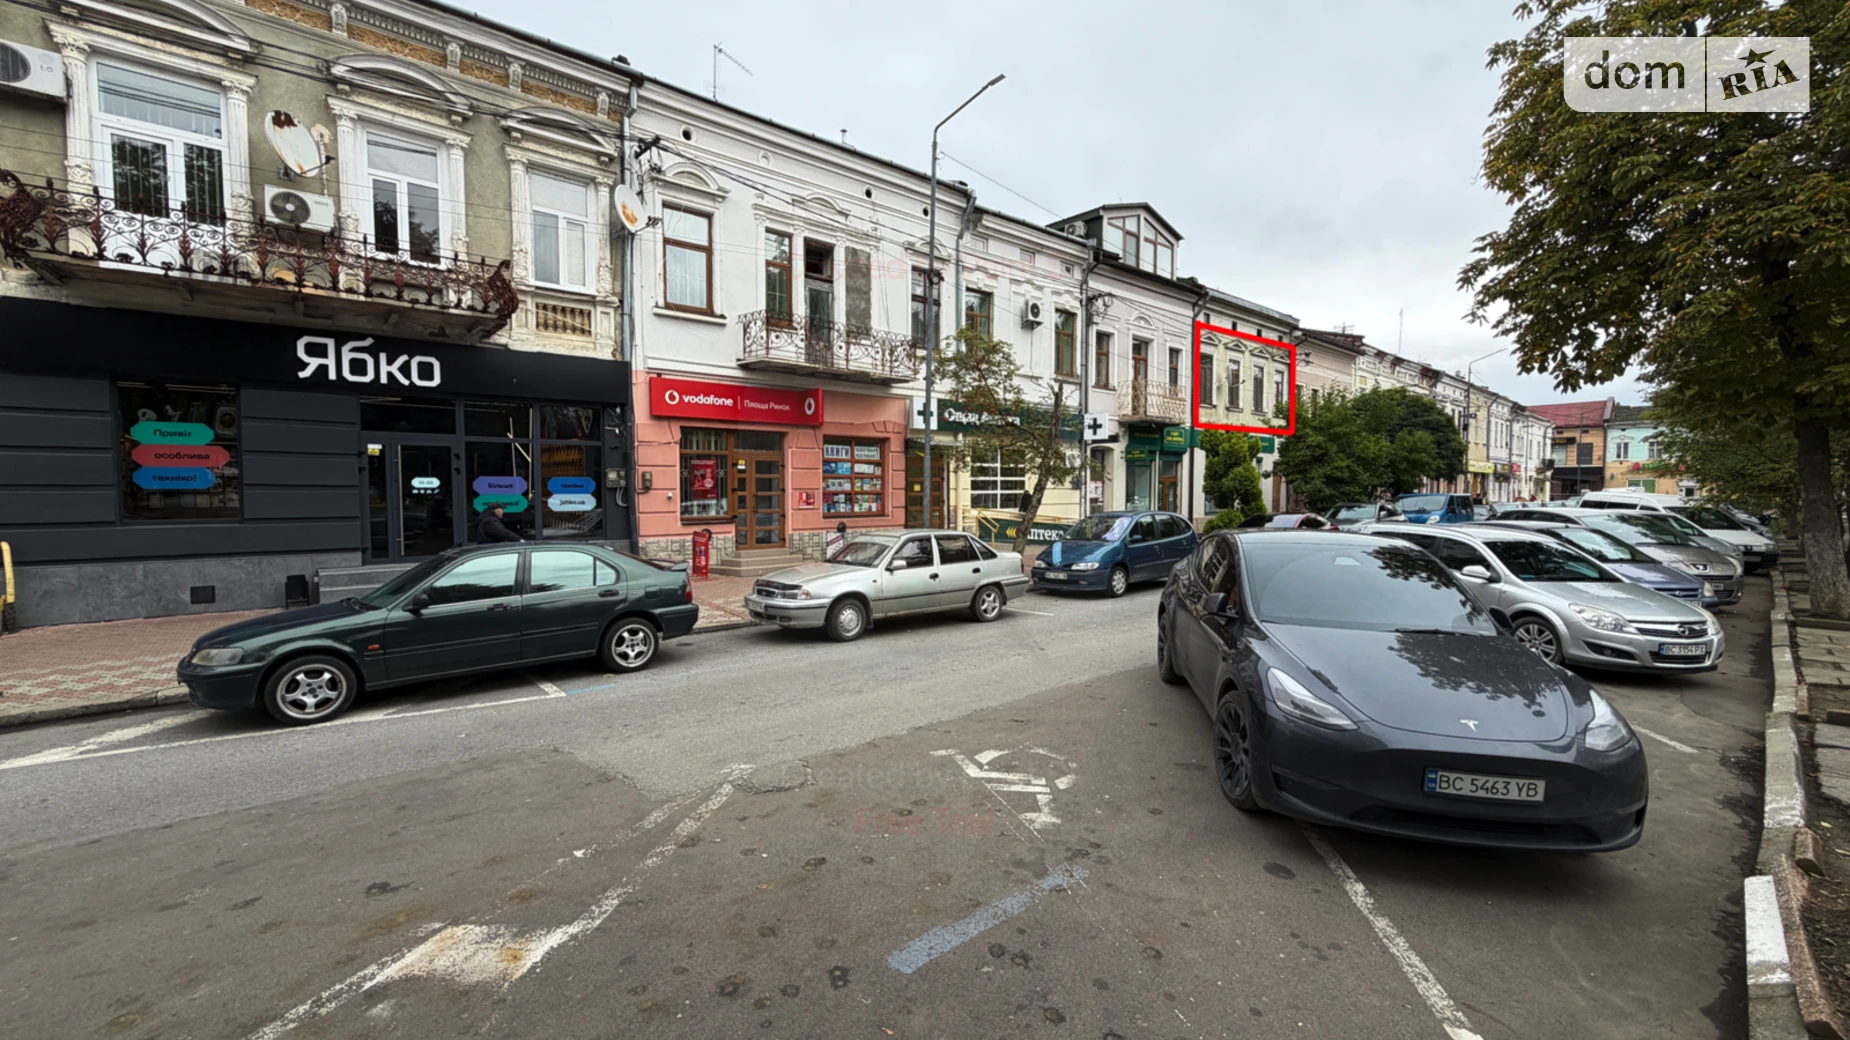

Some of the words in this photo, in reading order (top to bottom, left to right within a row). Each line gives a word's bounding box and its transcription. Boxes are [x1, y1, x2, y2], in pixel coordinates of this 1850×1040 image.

[296, 335, 442, 388] Ябко
[682, 393, 734, 407] vodafone
[744, 399, 769, 411] Площа
[769, 402, 790, 411] Ринок
[153, 428, 192, 438] Привіт
[154, 451, 210, 460] особлива
[825, 446, 850, 457] КНИГИ
[1438, 774, 1464, 791] BC
[1469, 778, 1511, 796] 5463
[1516, 782, 1538, 798] YB
